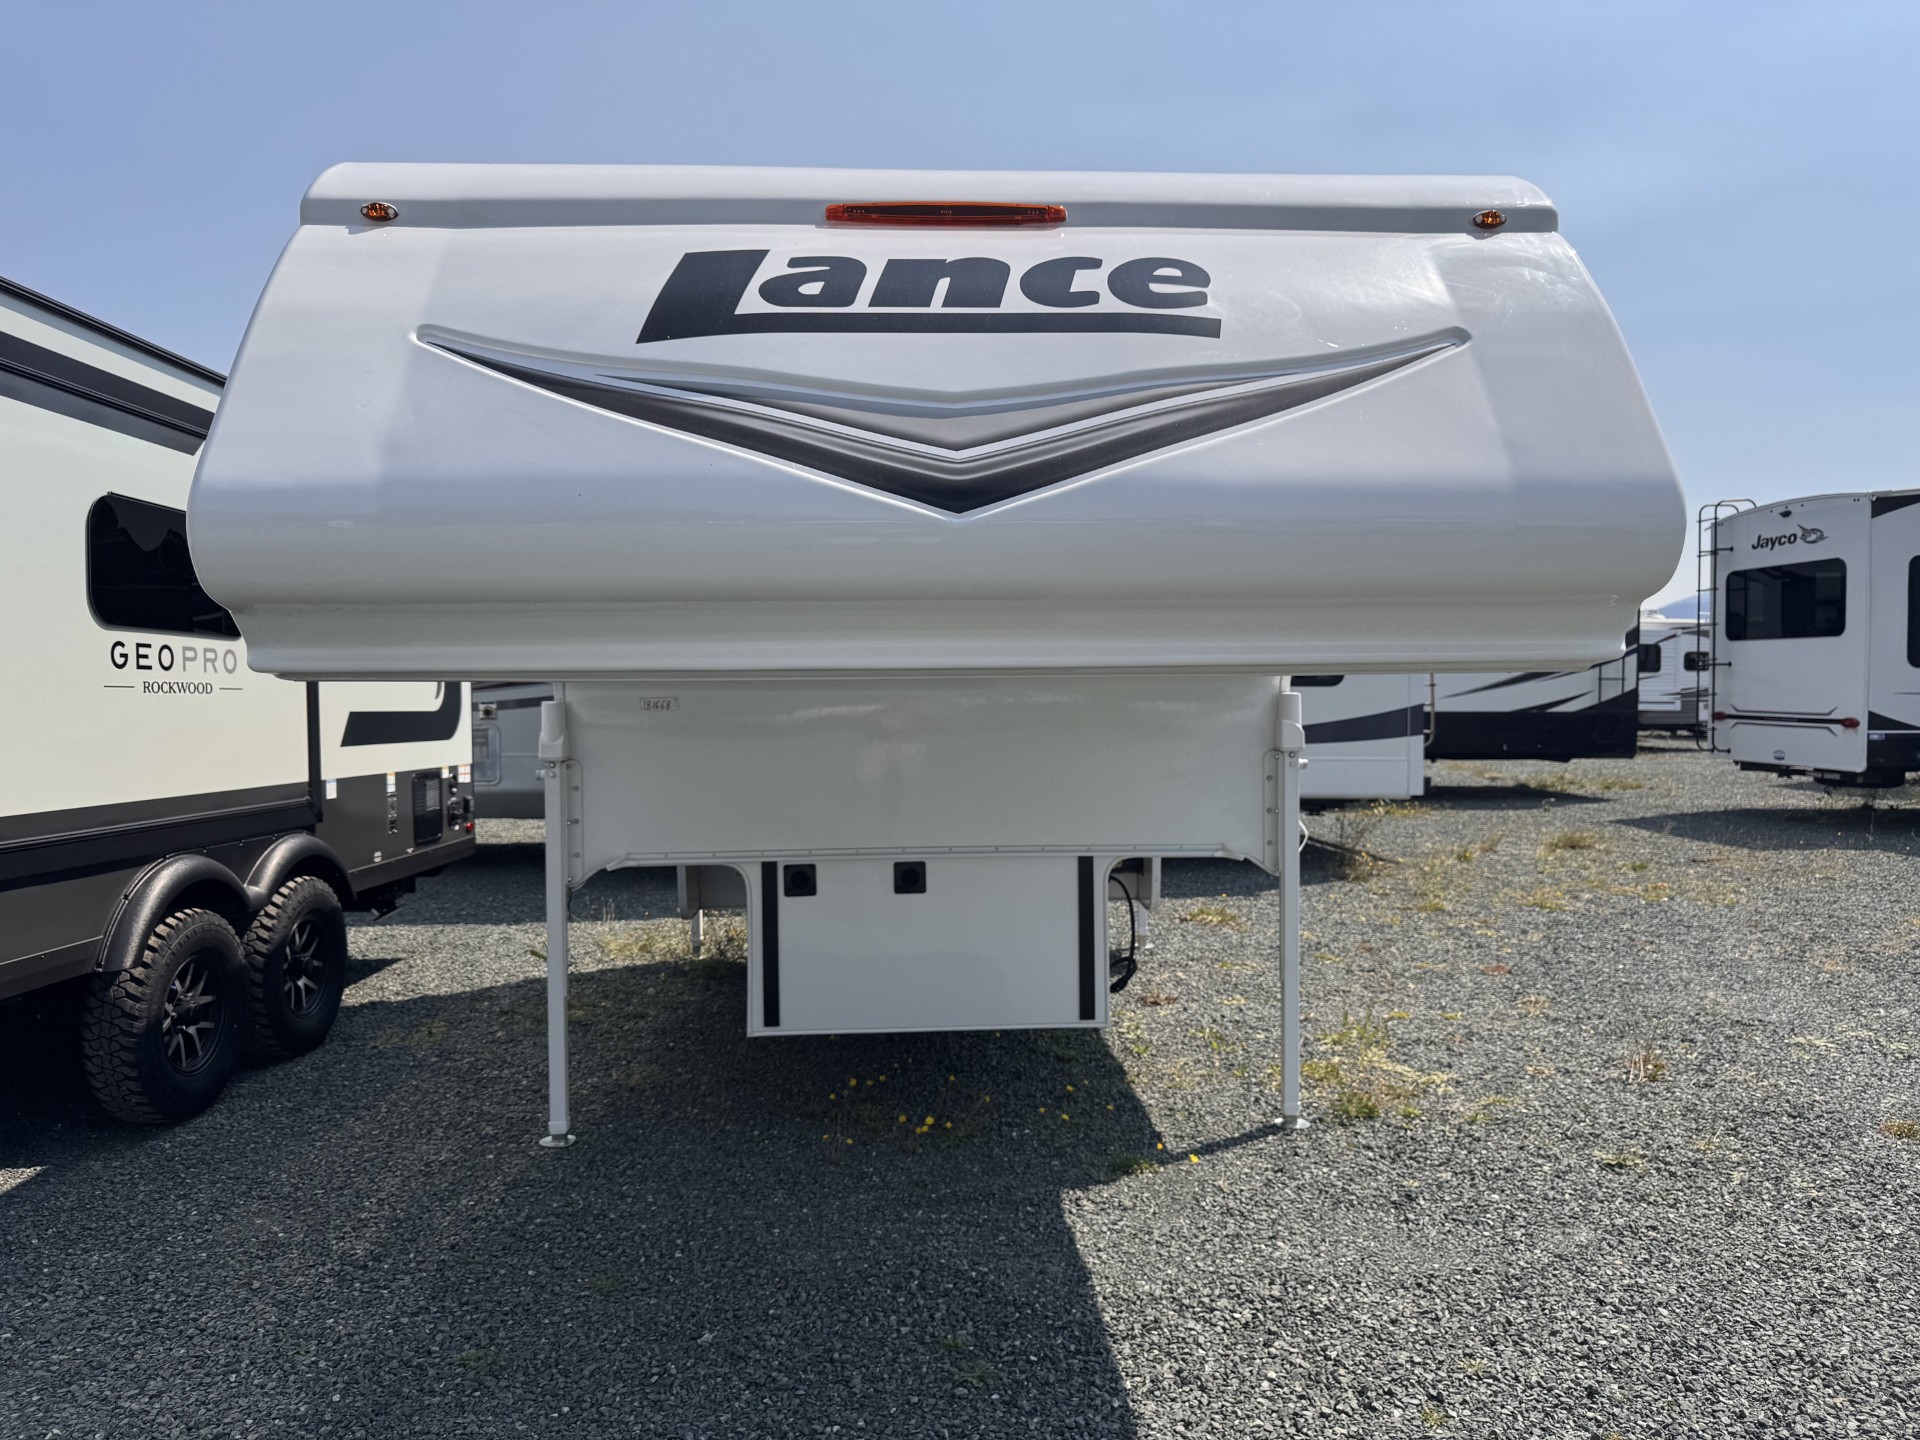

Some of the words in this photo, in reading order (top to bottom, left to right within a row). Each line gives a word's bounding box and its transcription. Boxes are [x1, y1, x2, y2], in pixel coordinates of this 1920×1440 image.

[636, 249, 1222, 344] Lance
[1751, 533, 1797, 551] Jayco
[143, 681, 213, 694] ROCKWOOD
